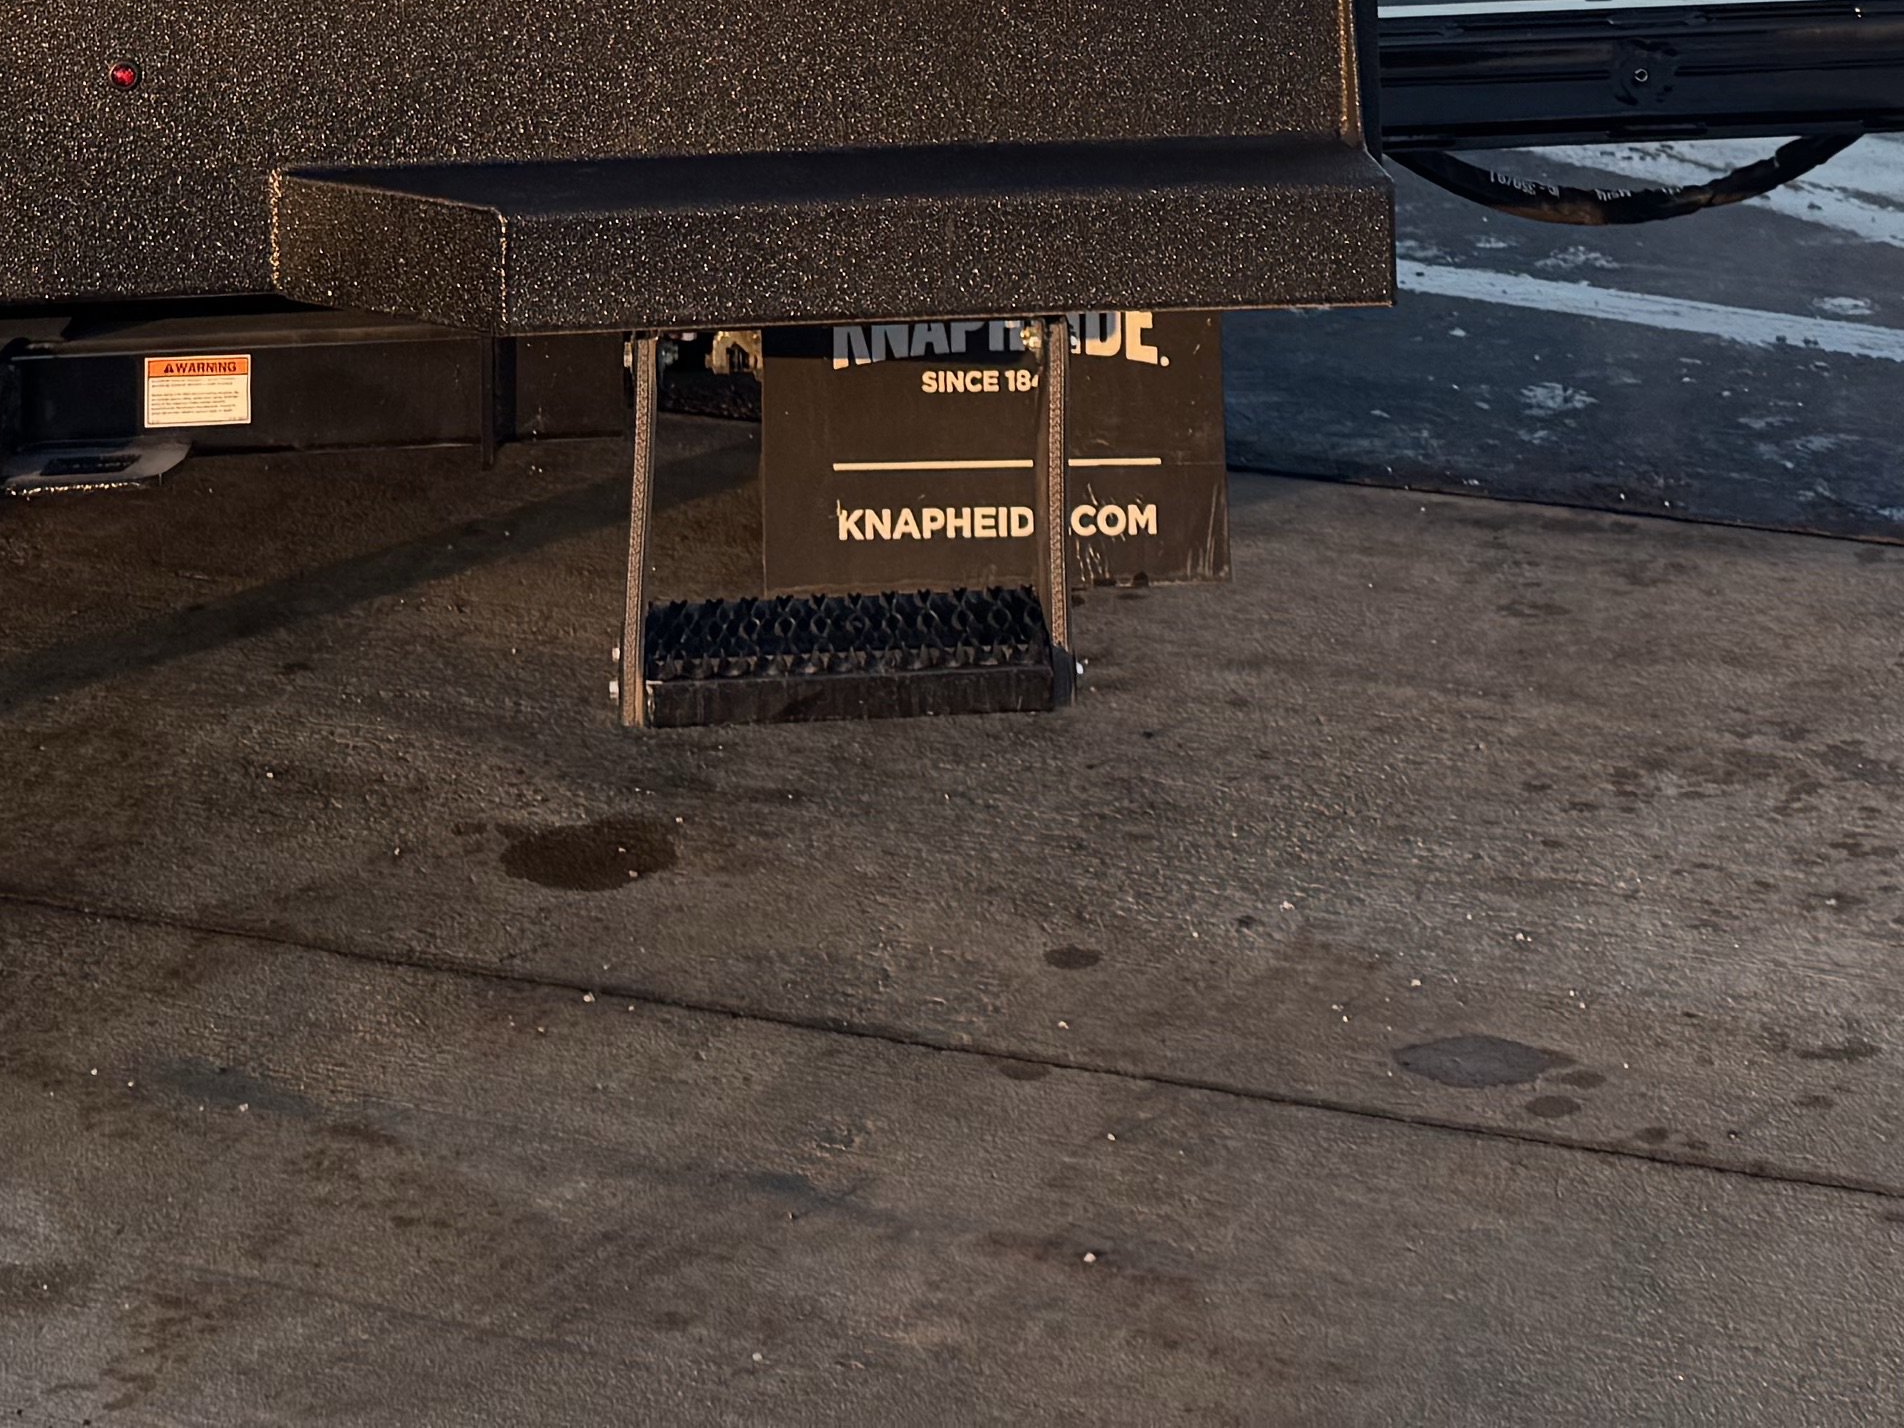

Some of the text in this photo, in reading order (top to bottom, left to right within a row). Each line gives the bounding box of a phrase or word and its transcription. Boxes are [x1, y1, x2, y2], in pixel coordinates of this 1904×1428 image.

[175, 361, 237, 373] WARNING
[921, 369, 1039, 393] SINCE 18
[837, 503, 1158, 541] KNAPHEIDCOM
